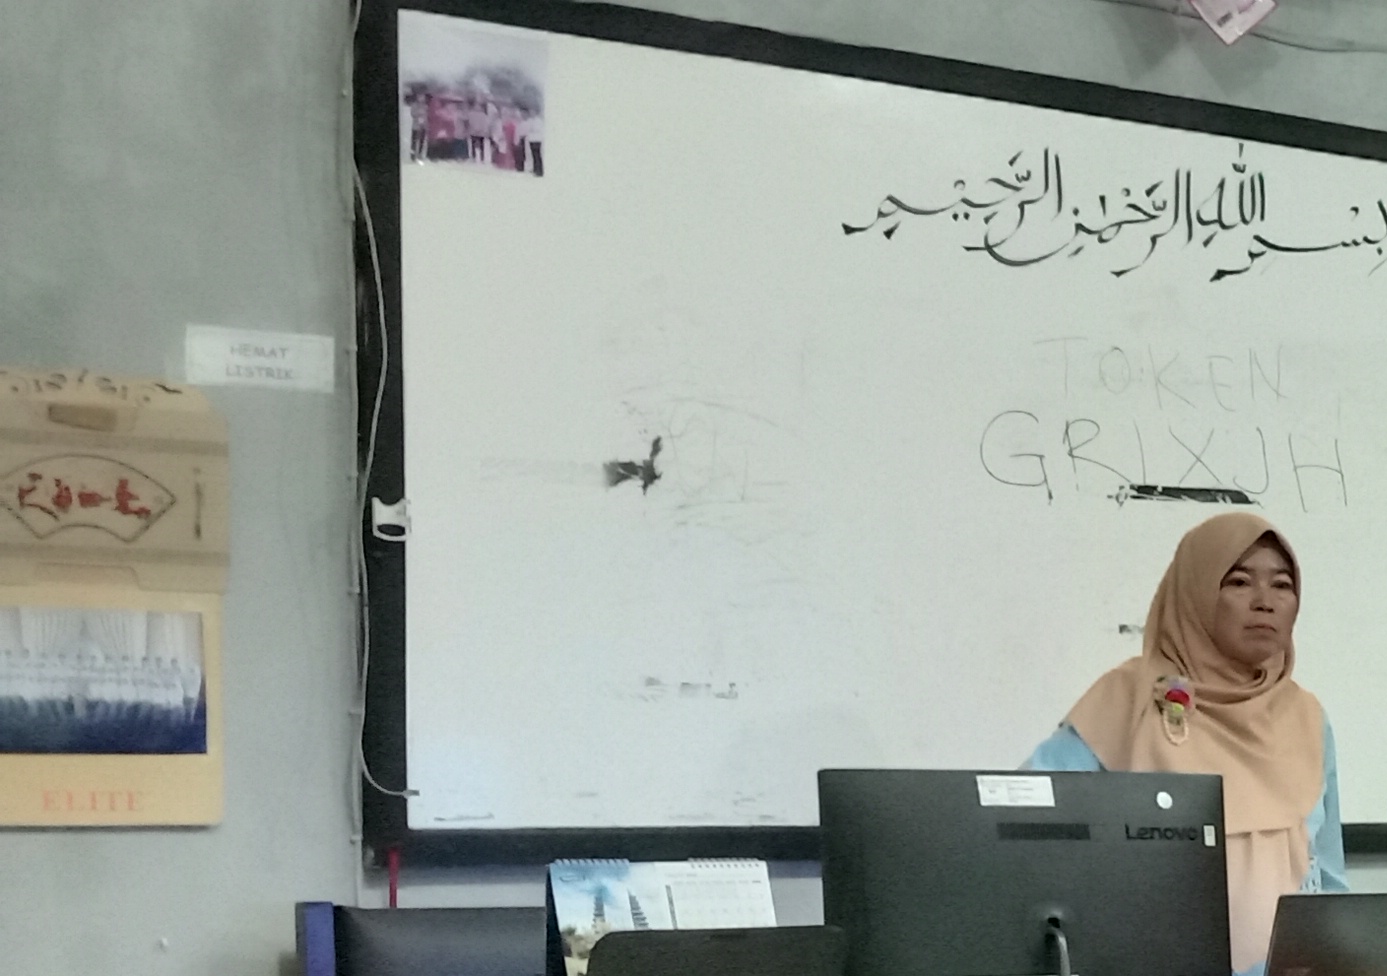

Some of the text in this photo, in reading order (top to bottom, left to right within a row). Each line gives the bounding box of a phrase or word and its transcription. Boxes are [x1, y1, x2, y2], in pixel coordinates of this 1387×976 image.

[229, 343, 289, 358] HEMAT
[1033, 336, 1288, 412] TOKEN
[1124, 822, 1200, 842] Lenovo
